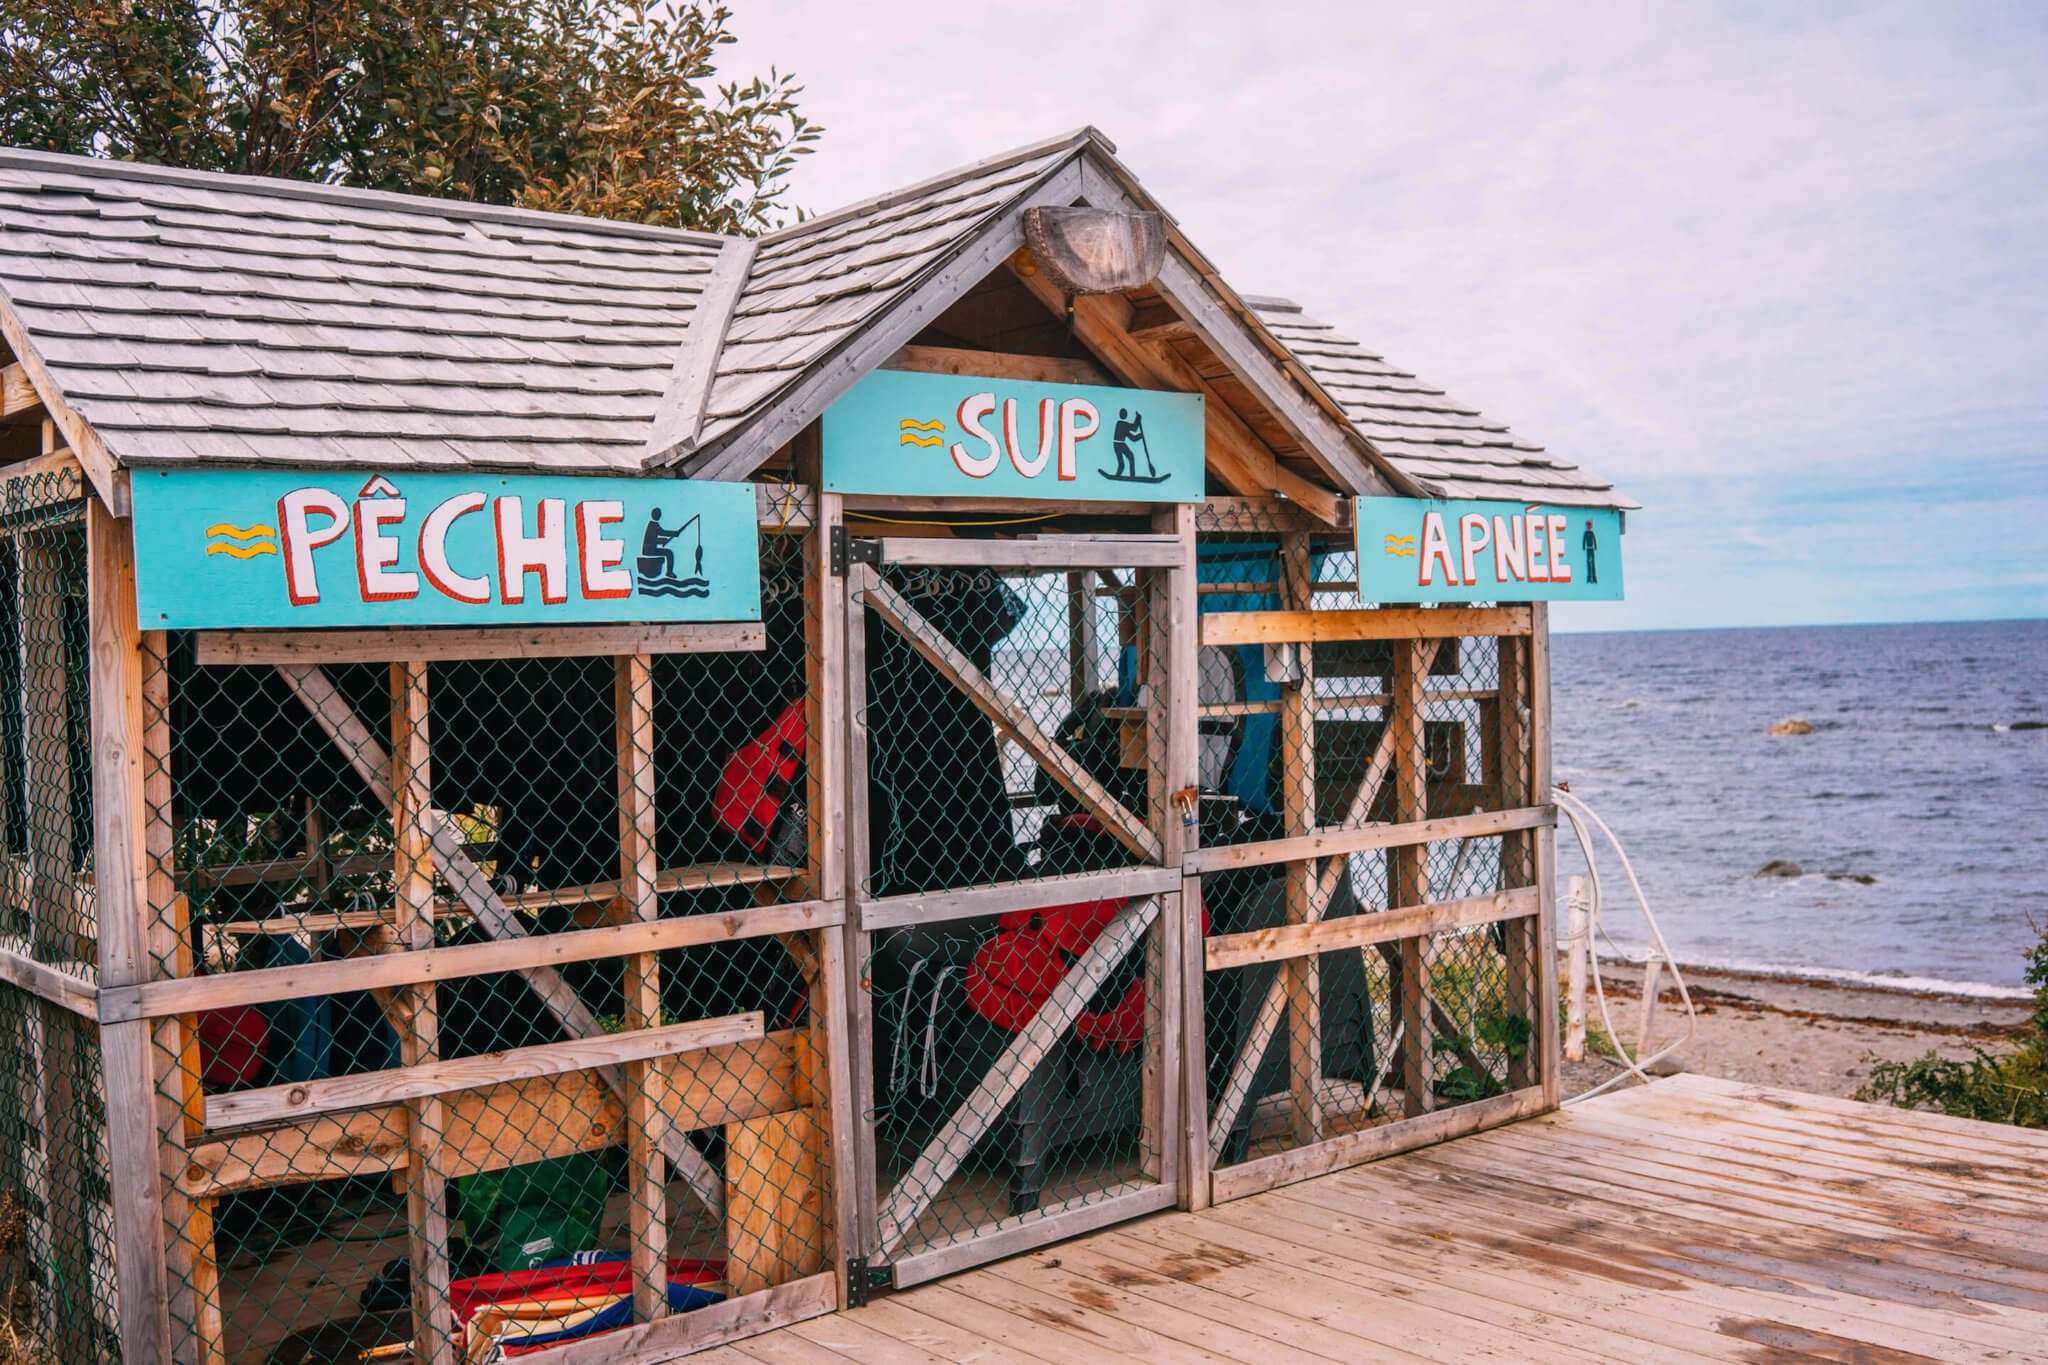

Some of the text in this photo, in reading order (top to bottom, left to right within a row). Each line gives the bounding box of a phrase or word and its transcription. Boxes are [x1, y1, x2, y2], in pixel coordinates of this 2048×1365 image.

[950, 392, 1100, 481] SUP
[277, 474, 632, 607] PÊCHE
[1419, 504, 1571, 586] APNÉE
